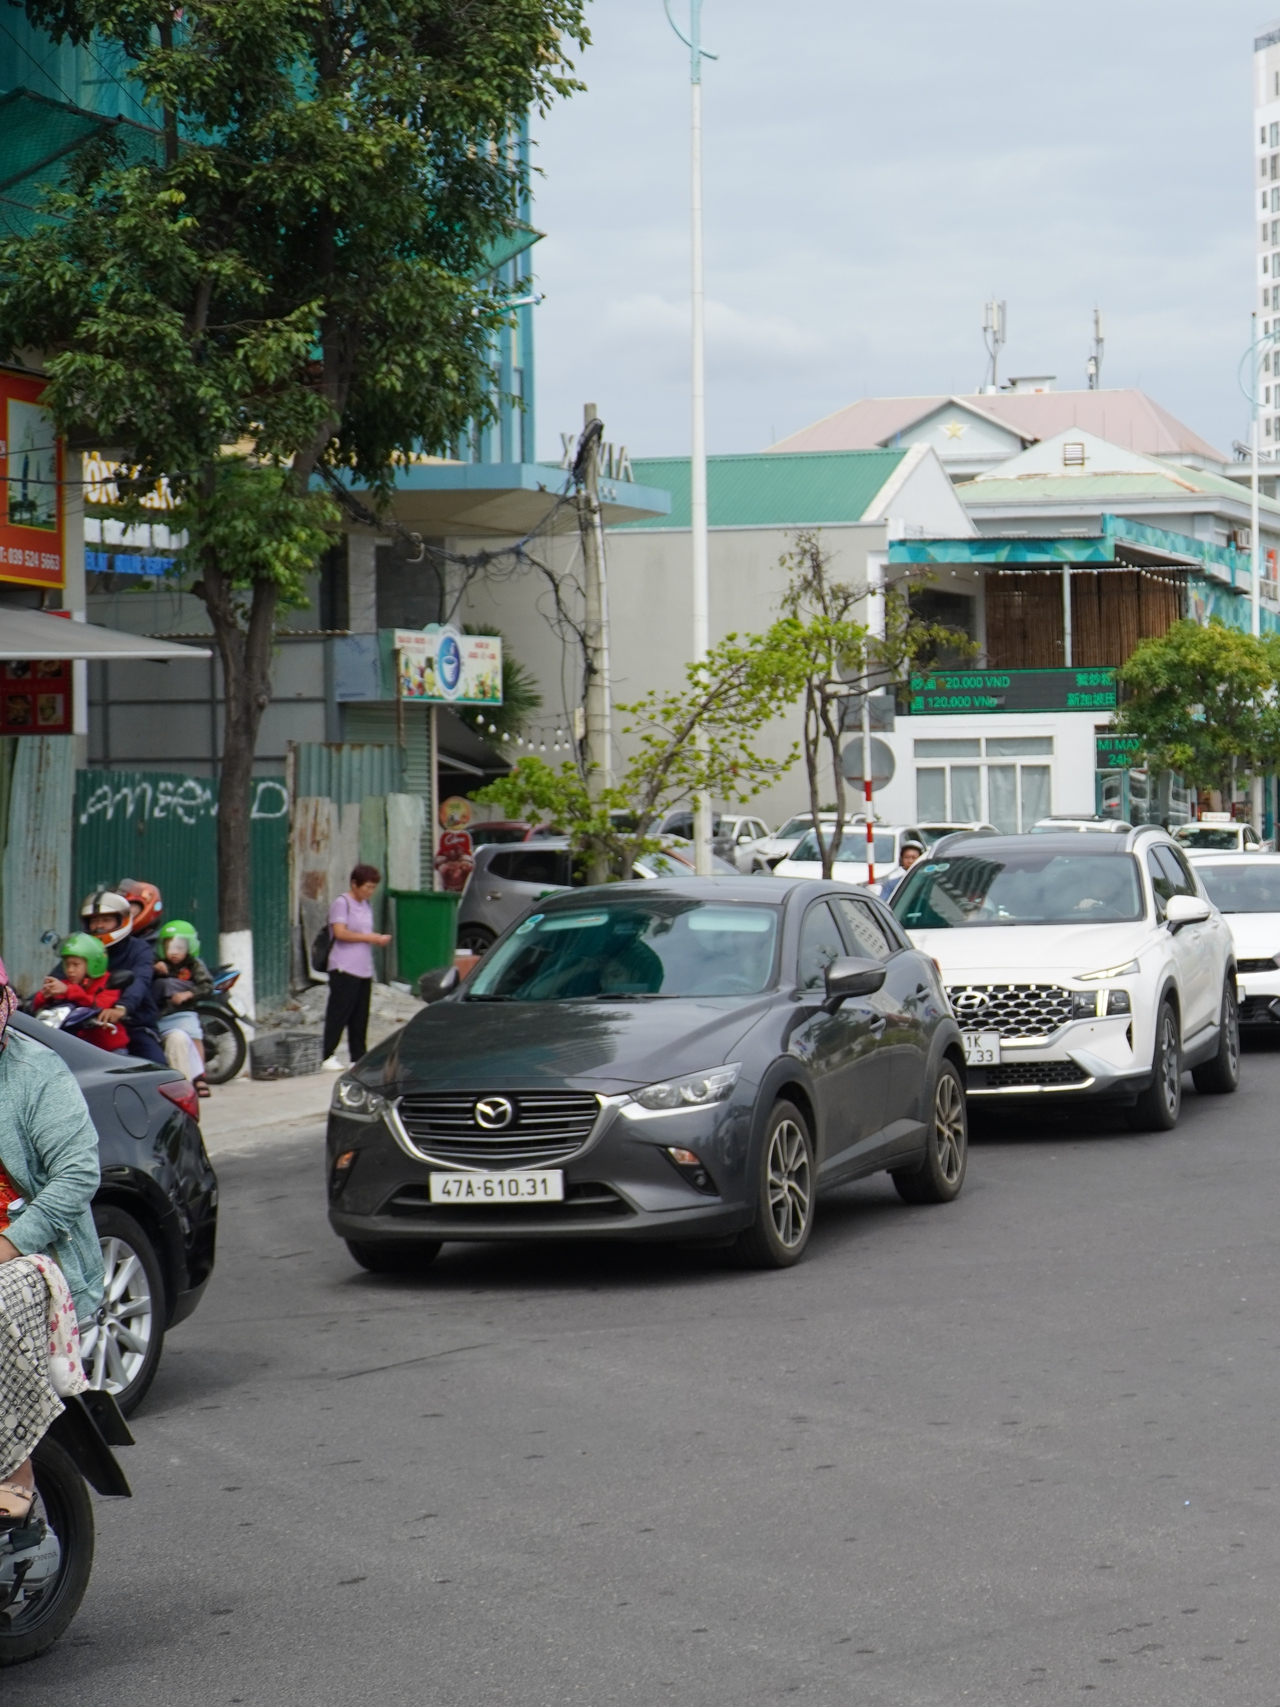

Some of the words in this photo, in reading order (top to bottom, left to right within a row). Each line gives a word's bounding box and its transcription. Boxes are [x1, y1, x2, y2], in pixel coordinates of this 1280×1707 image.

[8, 547, 23, 565] 039
[25, 550, 39, 567] 524
[985, 676, 1011, 689] VND
[927, 696, 971, 709] 120.000
[442, 1177, 549, 1198] 47A-610.31
